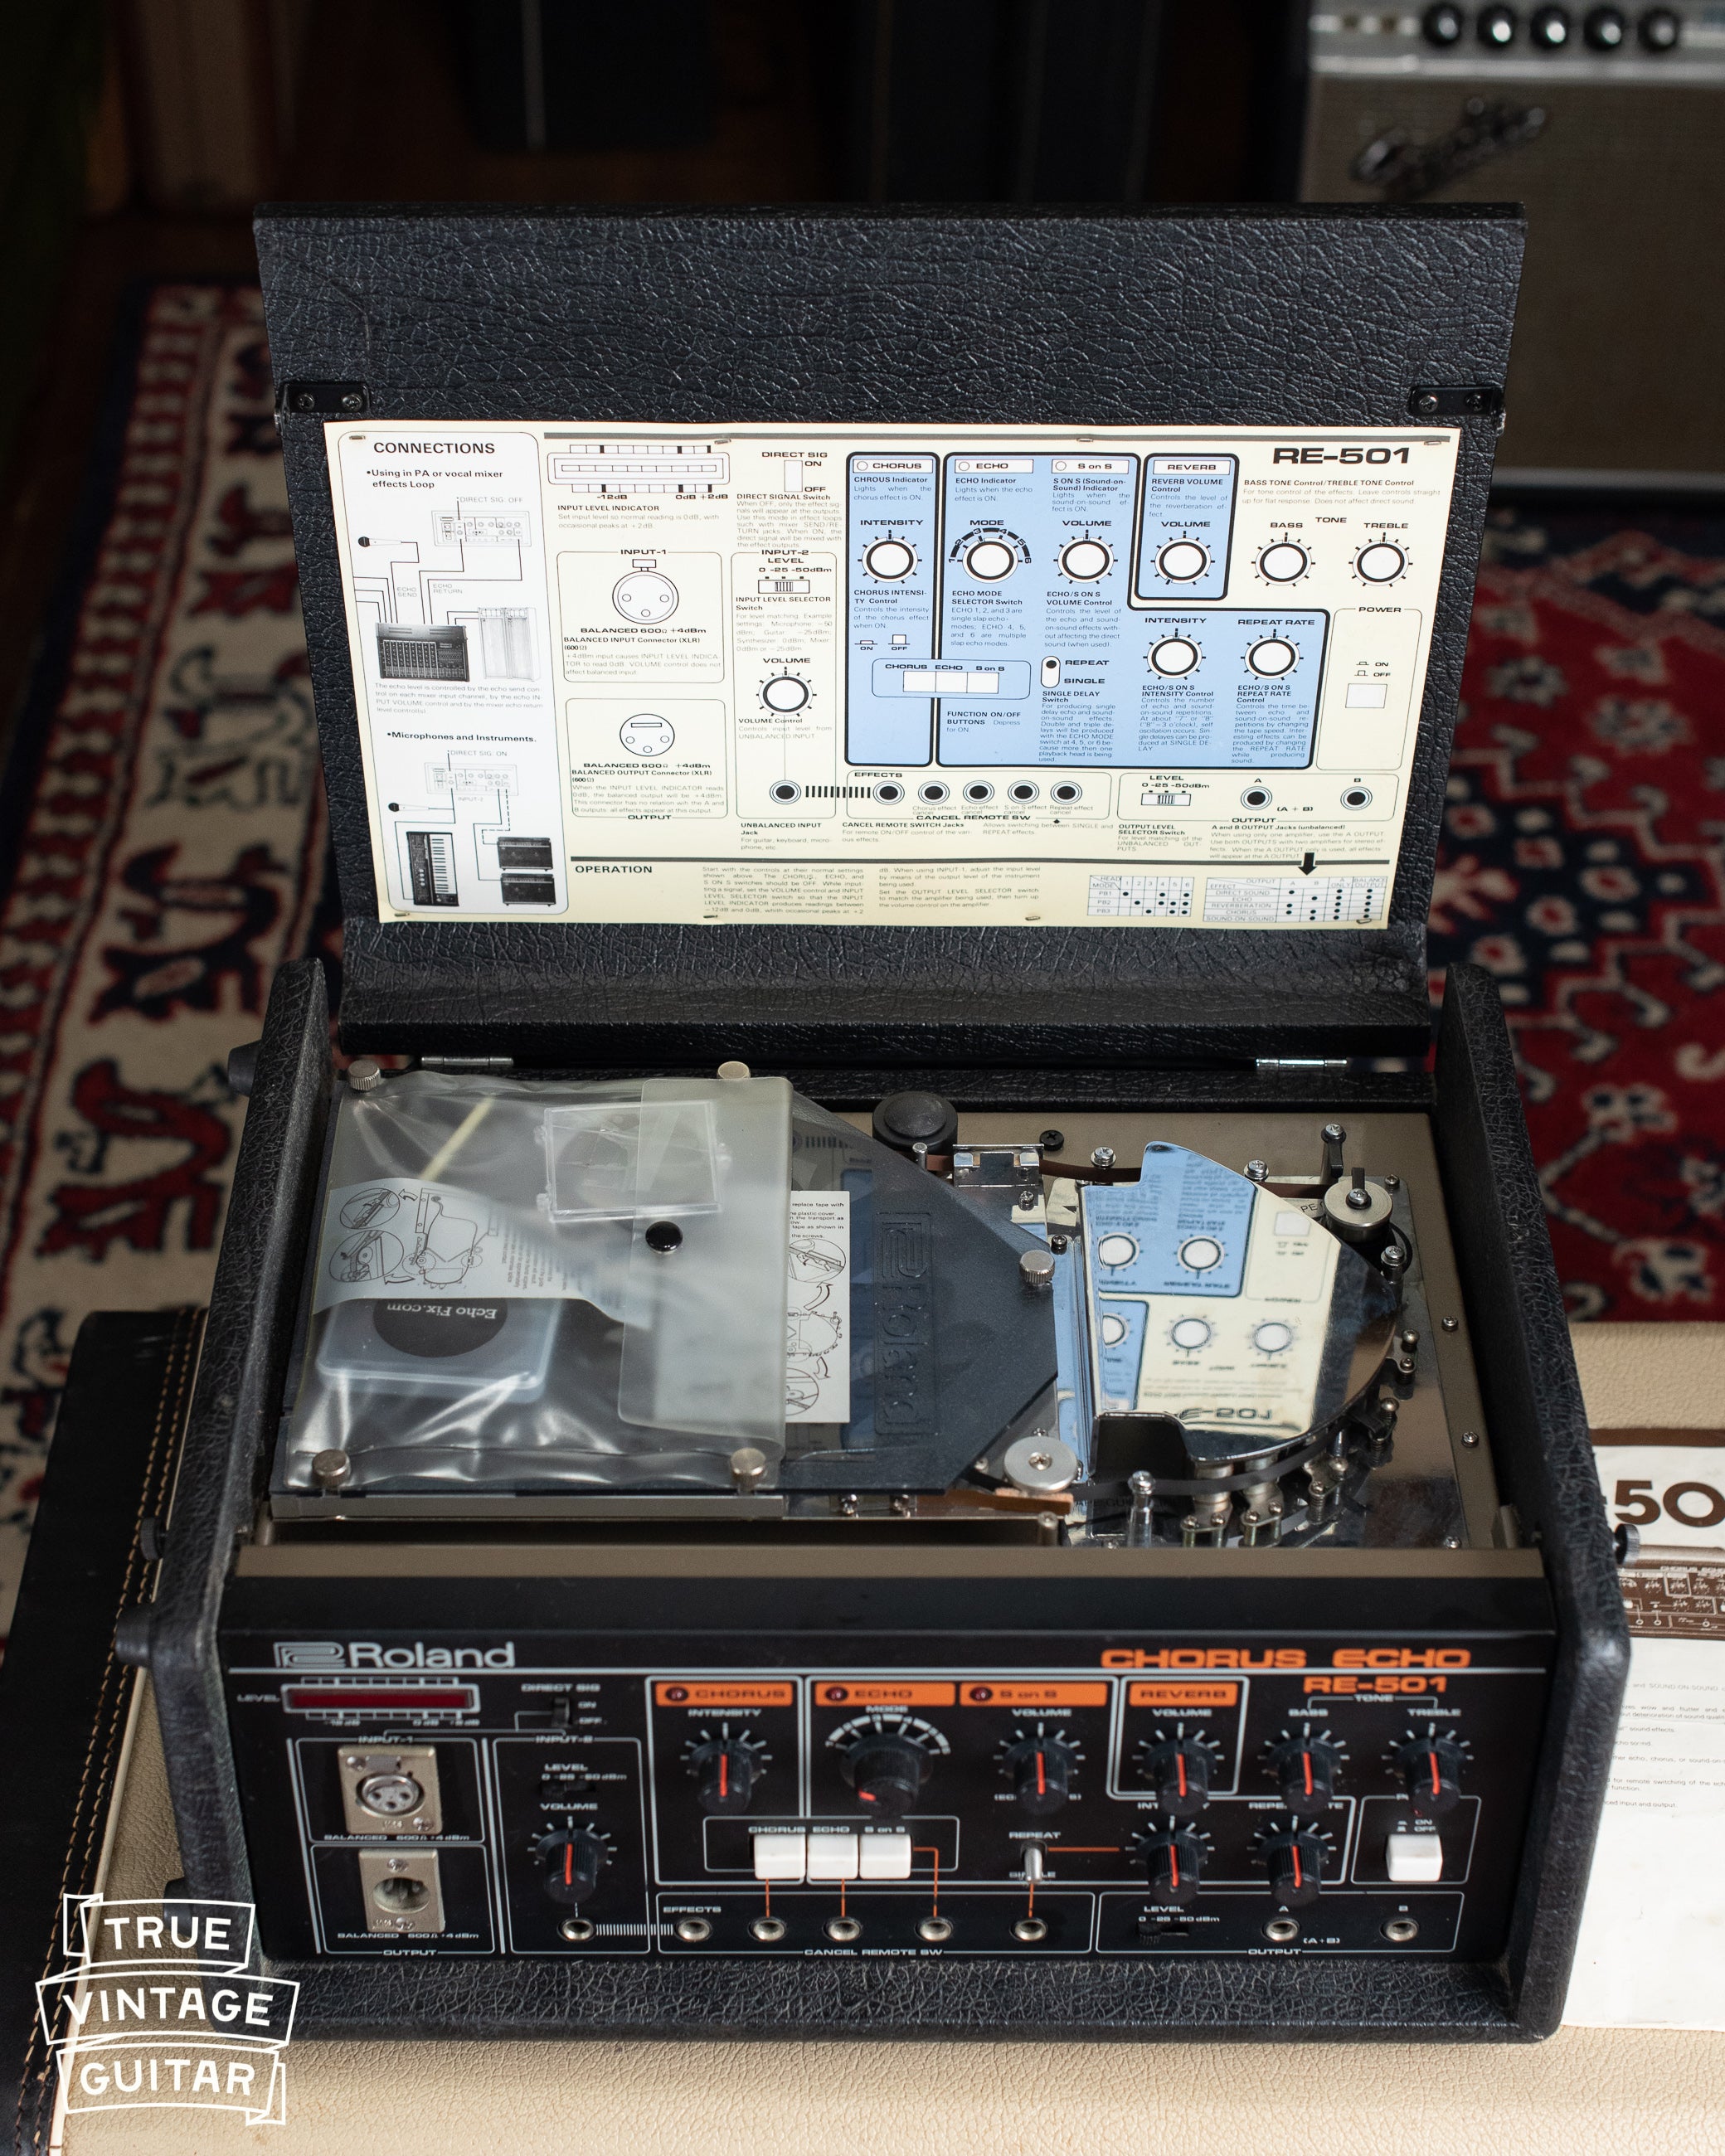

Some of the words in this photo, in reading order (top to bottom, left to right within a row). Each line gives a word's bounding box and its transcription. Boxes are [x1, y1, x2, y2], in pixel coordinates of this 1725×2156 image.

[374, 442, 495, 454] CONNECTIONS
[1273, 448, 1410, 464] RE-501
[372, 469, 400, 478] Using
[445, 469, 472, 478] vocal
[372, 480, 407, 488] effects
[410, 481, 435, 490] Loop
[391, 731, 454, 741] Microphones
[386, 1303, 451, 1317] Fix.com
[456, 1307, 497, 1318] Echo
[349, 1641, 515, 1668] Roland
[1101, 1649, 1306, 1668] CHORUS
[1332, 1649, 1471, 1668] ECHO
[1303, 1676, 1447, 1693] RE-501
[695, 1690, 785, 1698] CHORUS
[855, 1690, 912, 1698] ECHO
[1140, 1689, 1227, 1699] REVERB
[1354, 1694, 1393, 1702] TONE
[688, 1709, 761, 1717] INTENSITY
[1012, 1708, 1071, 1717] VOLUME
[1153, 1709, 1212, 1717] VOLUME
[1407, 1708, 1461, 1717] TREBLE
[540, 1803, 598, 1811] VOLUME
